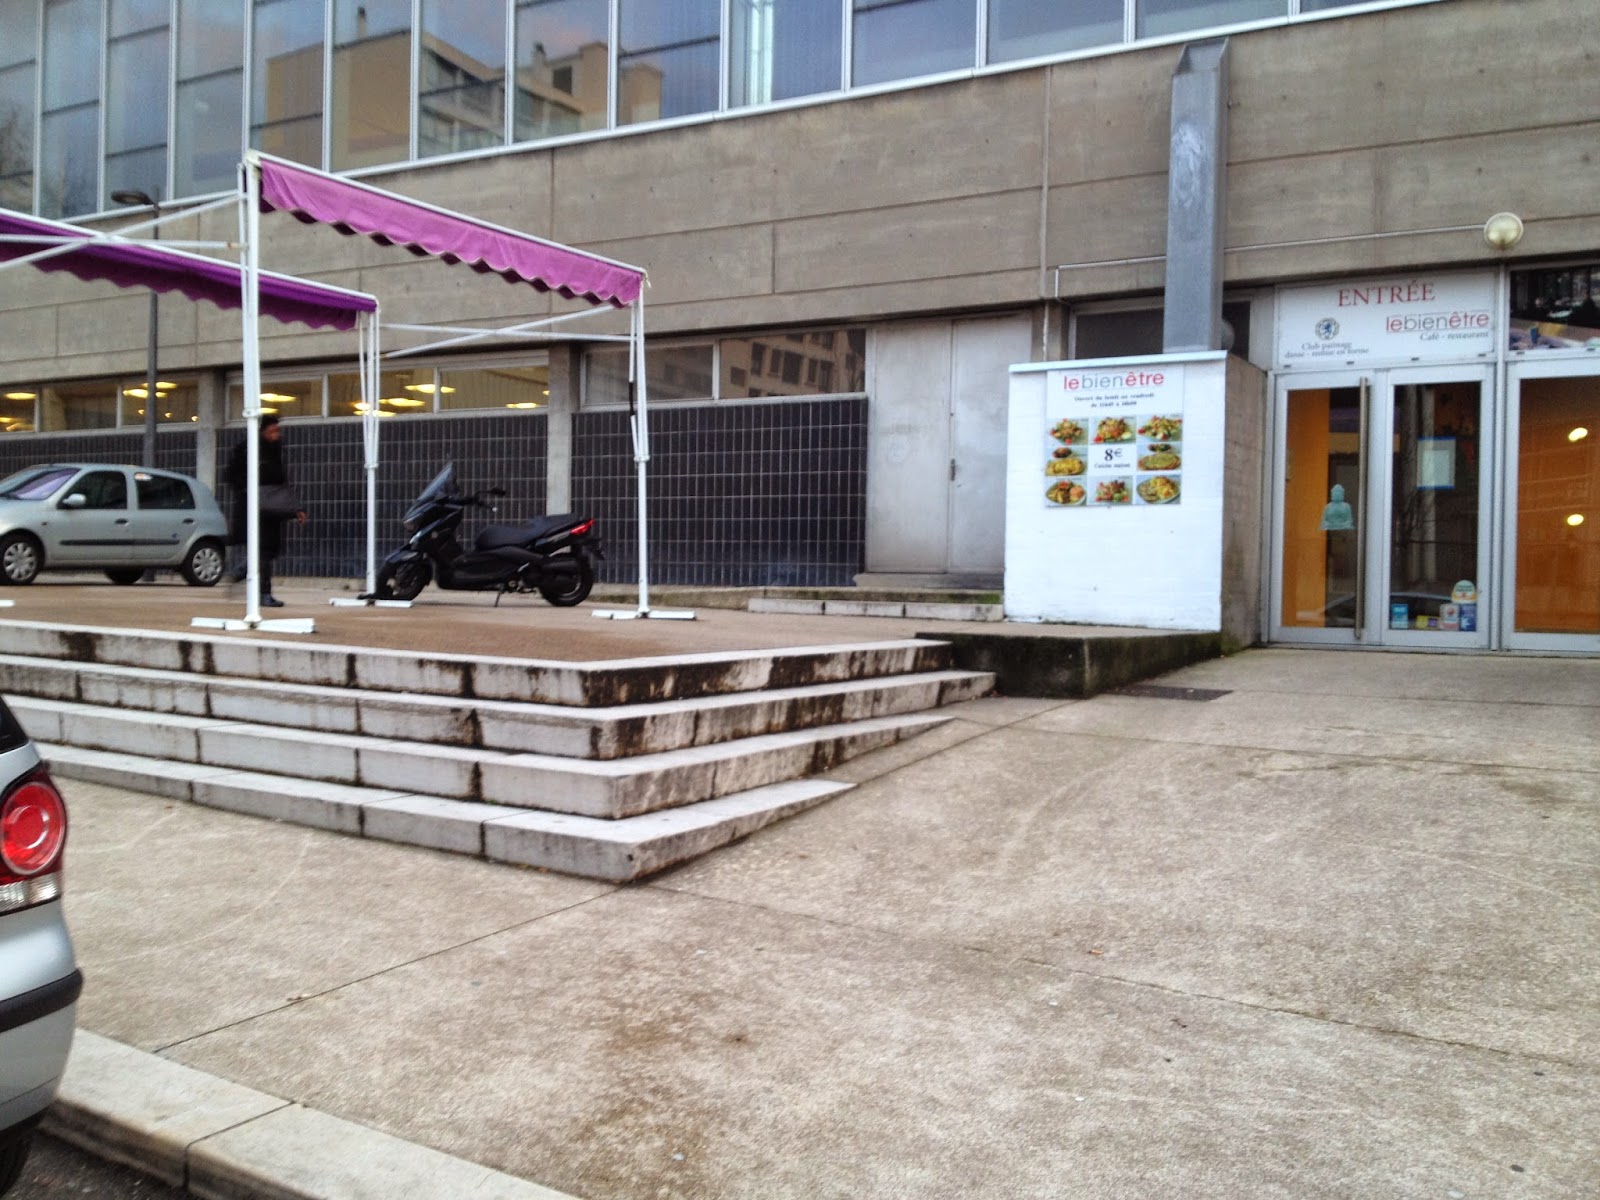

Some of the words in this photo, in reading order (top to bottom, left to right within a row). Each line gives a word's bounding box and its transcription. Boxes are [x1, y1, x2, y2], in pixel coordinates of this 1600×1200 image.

[1338, 280, 1435, 307] ENTRÉE
[1386, 311, 1489, 332] lebienêtre
[1420, 331, 1439, 341] Café
[1447, 331, 1489, 340] restaurant
[1301, 342, 1320, 350] Club
[1063, 371, 1165, 390] lebienêtre
[1104, 448, 1123, 461] 8€
